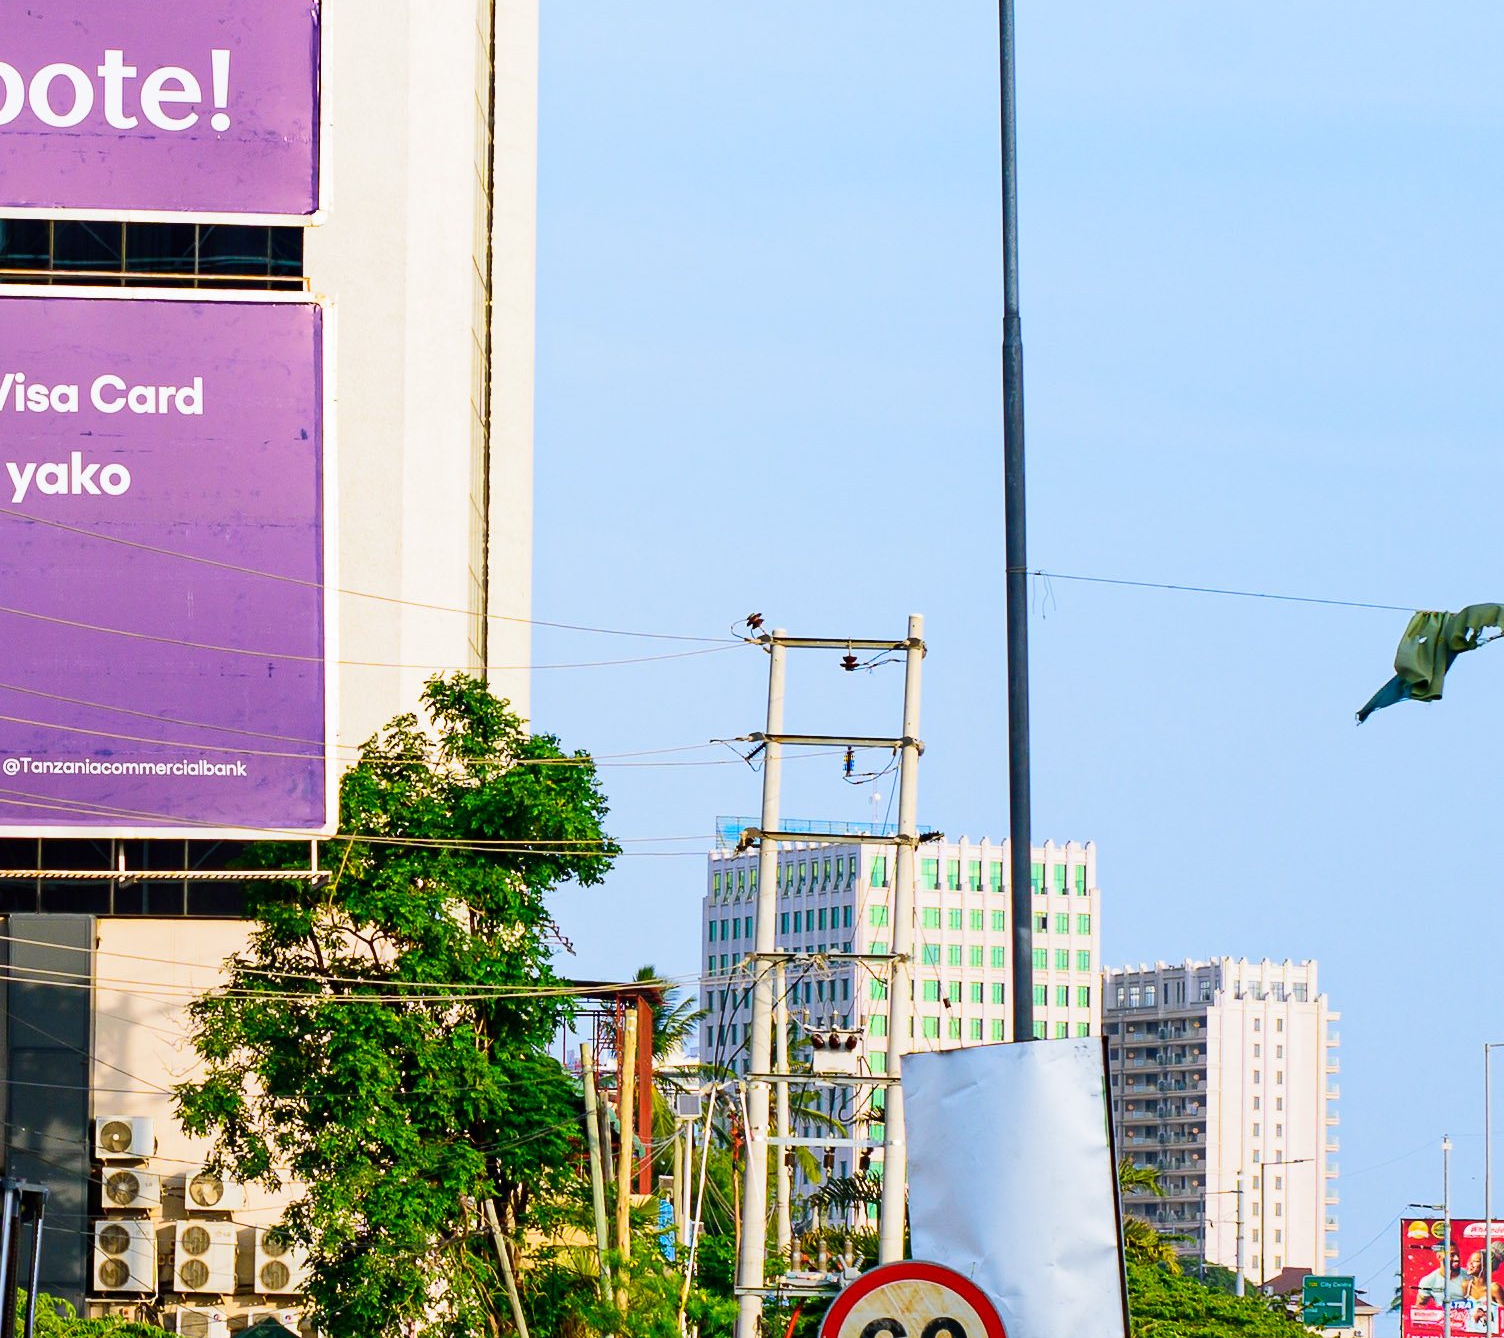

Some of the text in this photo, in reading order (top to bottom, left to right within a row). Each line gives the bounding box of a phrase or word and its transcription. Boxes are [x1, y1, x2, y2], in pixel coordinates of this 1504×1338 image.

[89, 374, 204, 417] Card
[5, 452, 131, 505] yako
[1, 756, 249, 779] @Tanzaniacommercialbank
